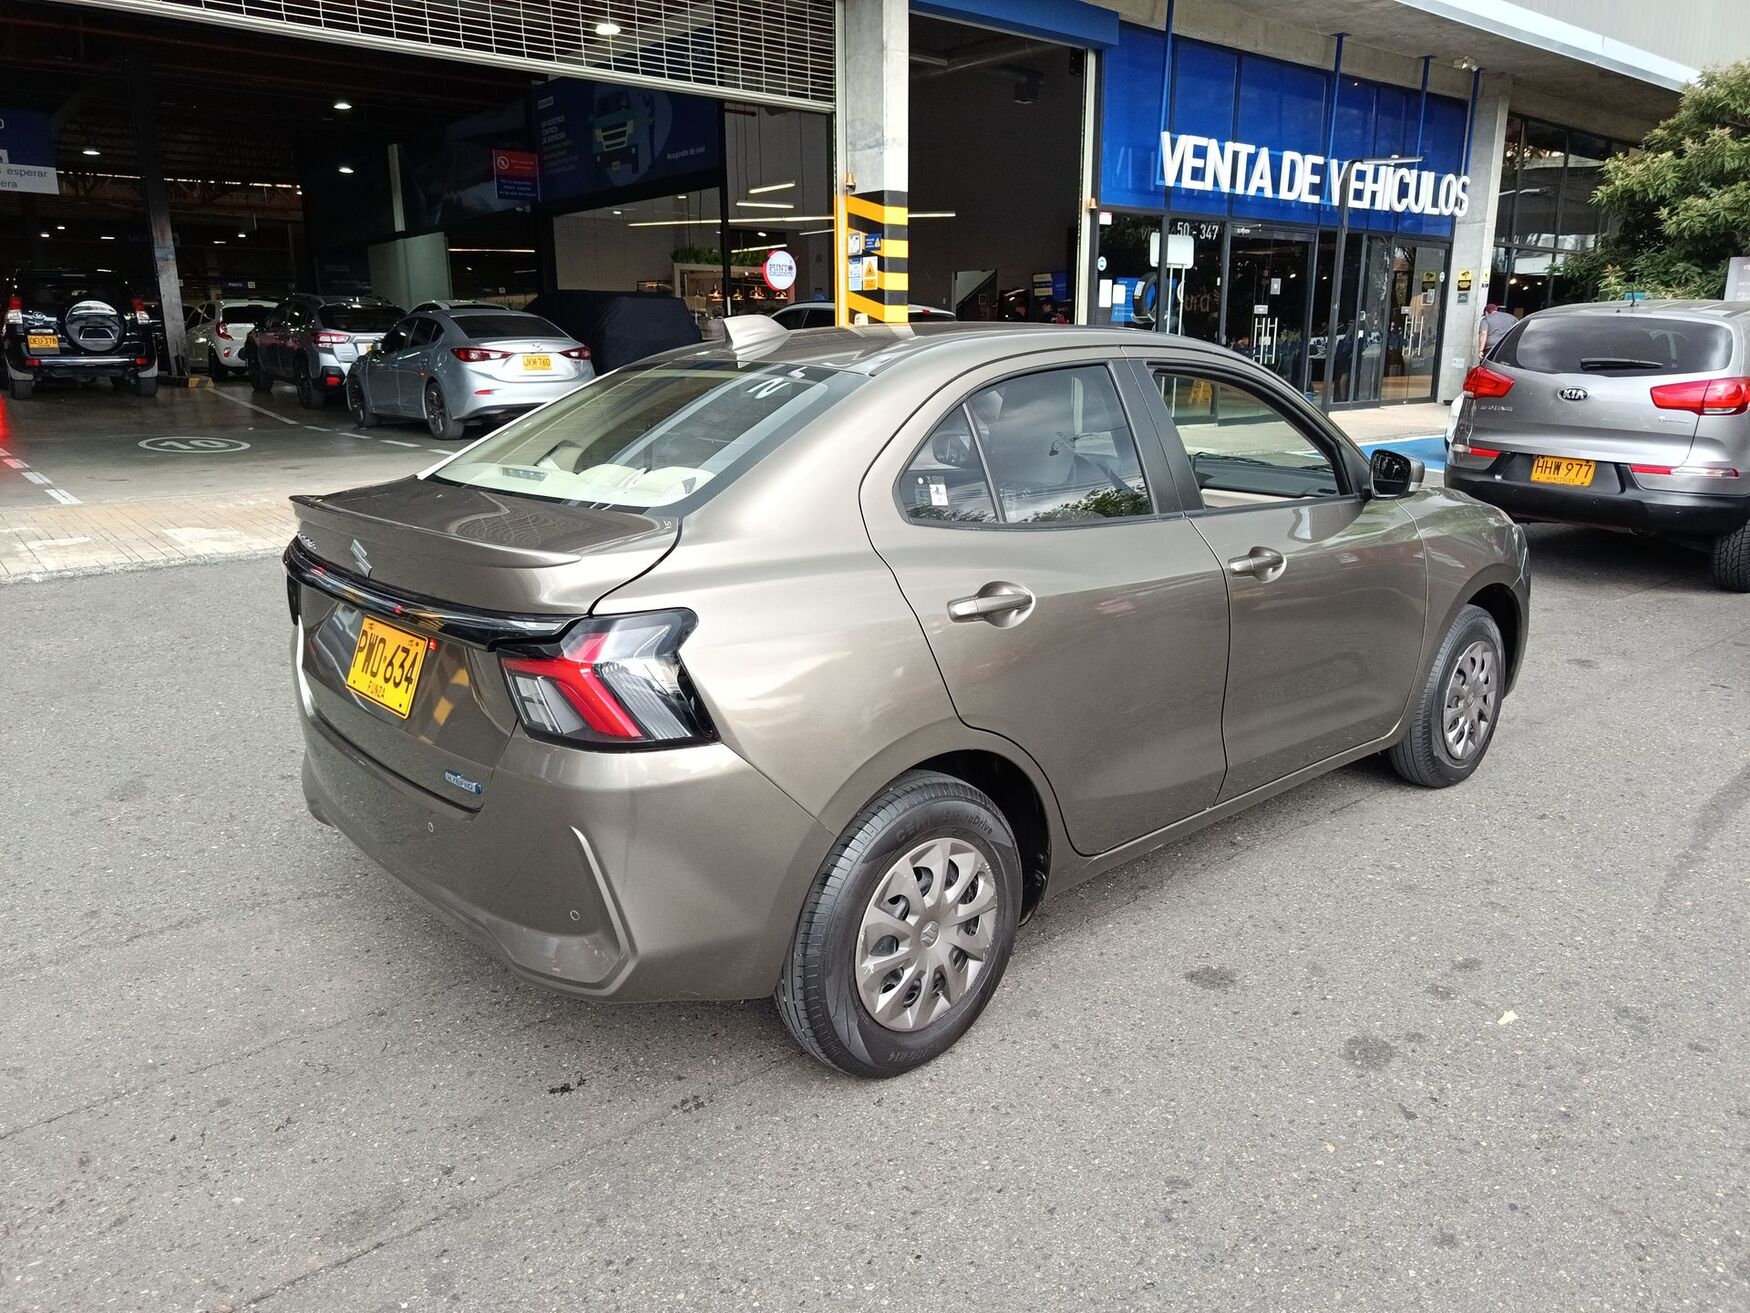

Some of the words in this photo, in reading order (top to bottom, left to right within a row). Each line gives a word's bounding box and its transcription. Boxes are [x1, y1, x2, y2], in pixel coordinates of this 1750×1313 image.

[7, 167, 48, 177] esperar
[1160, 131, 1273, 198] VENTA
[1279, 150, 1325, 204] DE
[1177, 221, 1190, 236] 50
[1199, 224, 1219, 241] 347
[1562, 389, 1585, 400] KIA
[1564, 462, 1592, 479] 977
